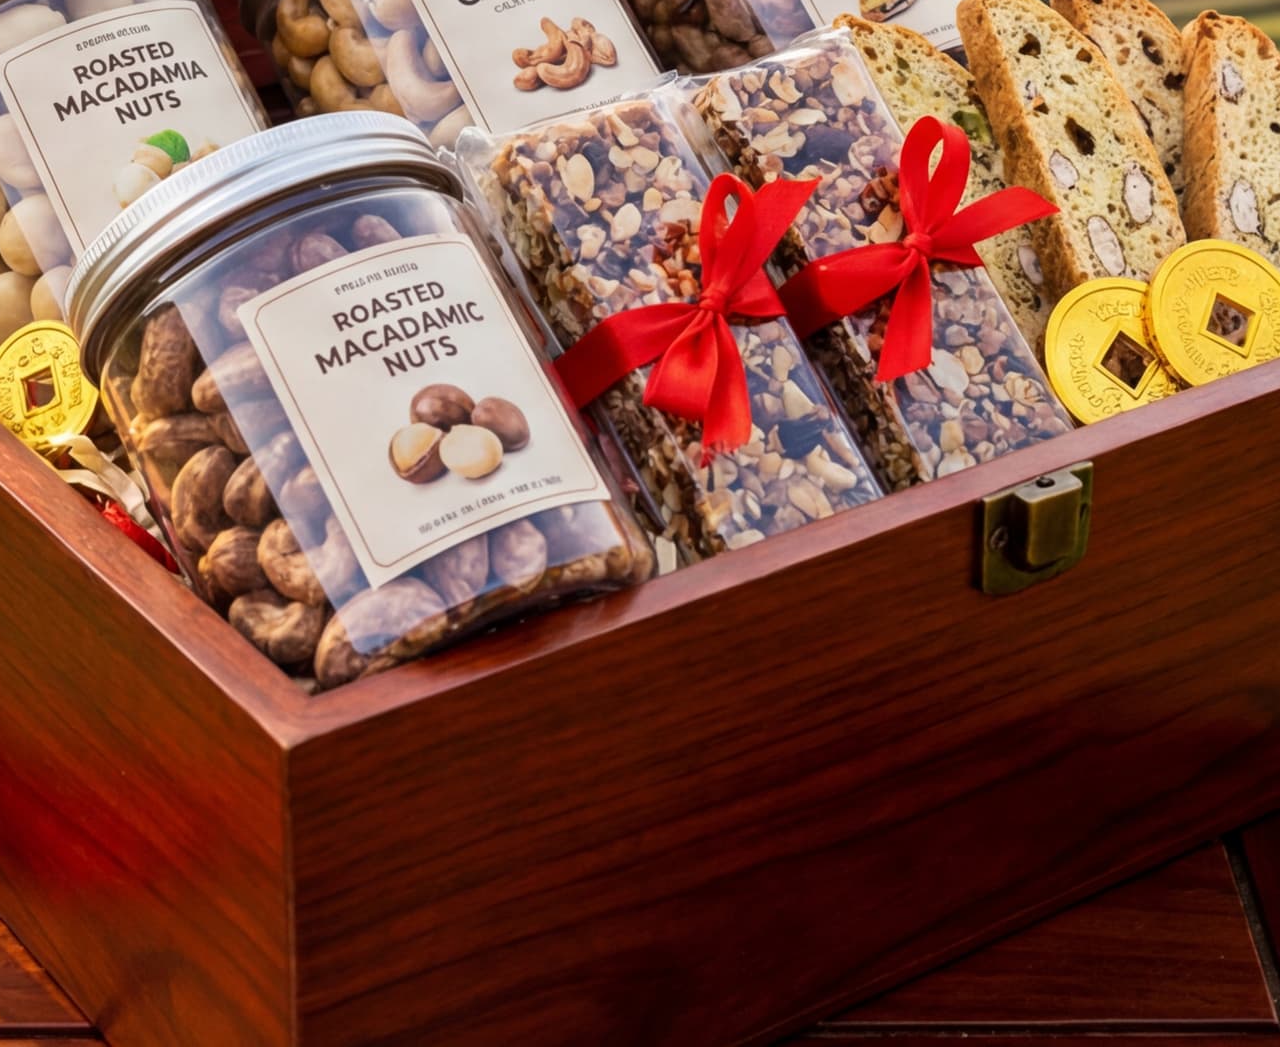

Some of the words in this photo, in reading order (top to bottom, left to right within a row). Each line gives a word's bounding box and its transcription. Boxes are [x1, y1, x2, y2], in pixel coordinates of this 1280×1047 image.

[72, 40, 175, 84] ROASTED
[52, 60, 208, 122] MACADAMIA
[114, 89, 182, 125] NUTS
[331, 280, 445, 332] ROASTED
[314, 300, 485, 375] MACADAMIC
[382, 335, 459, 377] NUTS
